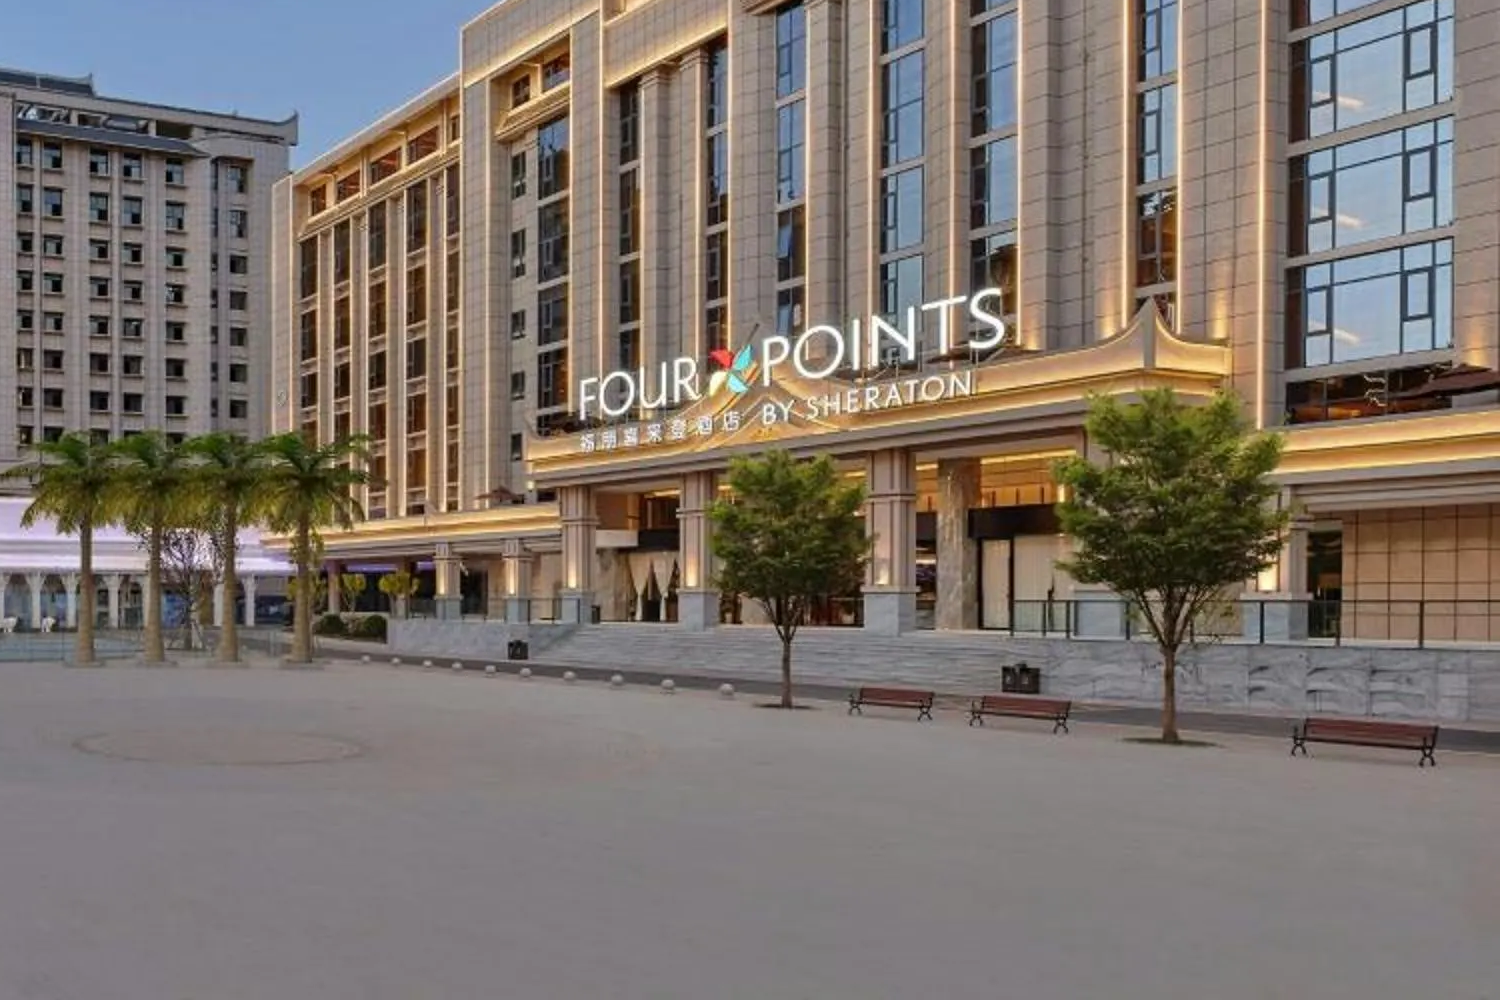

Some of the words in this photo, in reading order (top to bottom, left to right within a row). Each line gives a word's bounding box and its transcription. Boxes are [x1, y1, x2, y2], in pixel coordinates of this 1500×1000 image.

[579, 357, 700, 421] FOUR
[762, 288, 1006, 387] POINTS
[762, 398, 795, 425] BY
[806, 370, 974, 420] SHERATON
